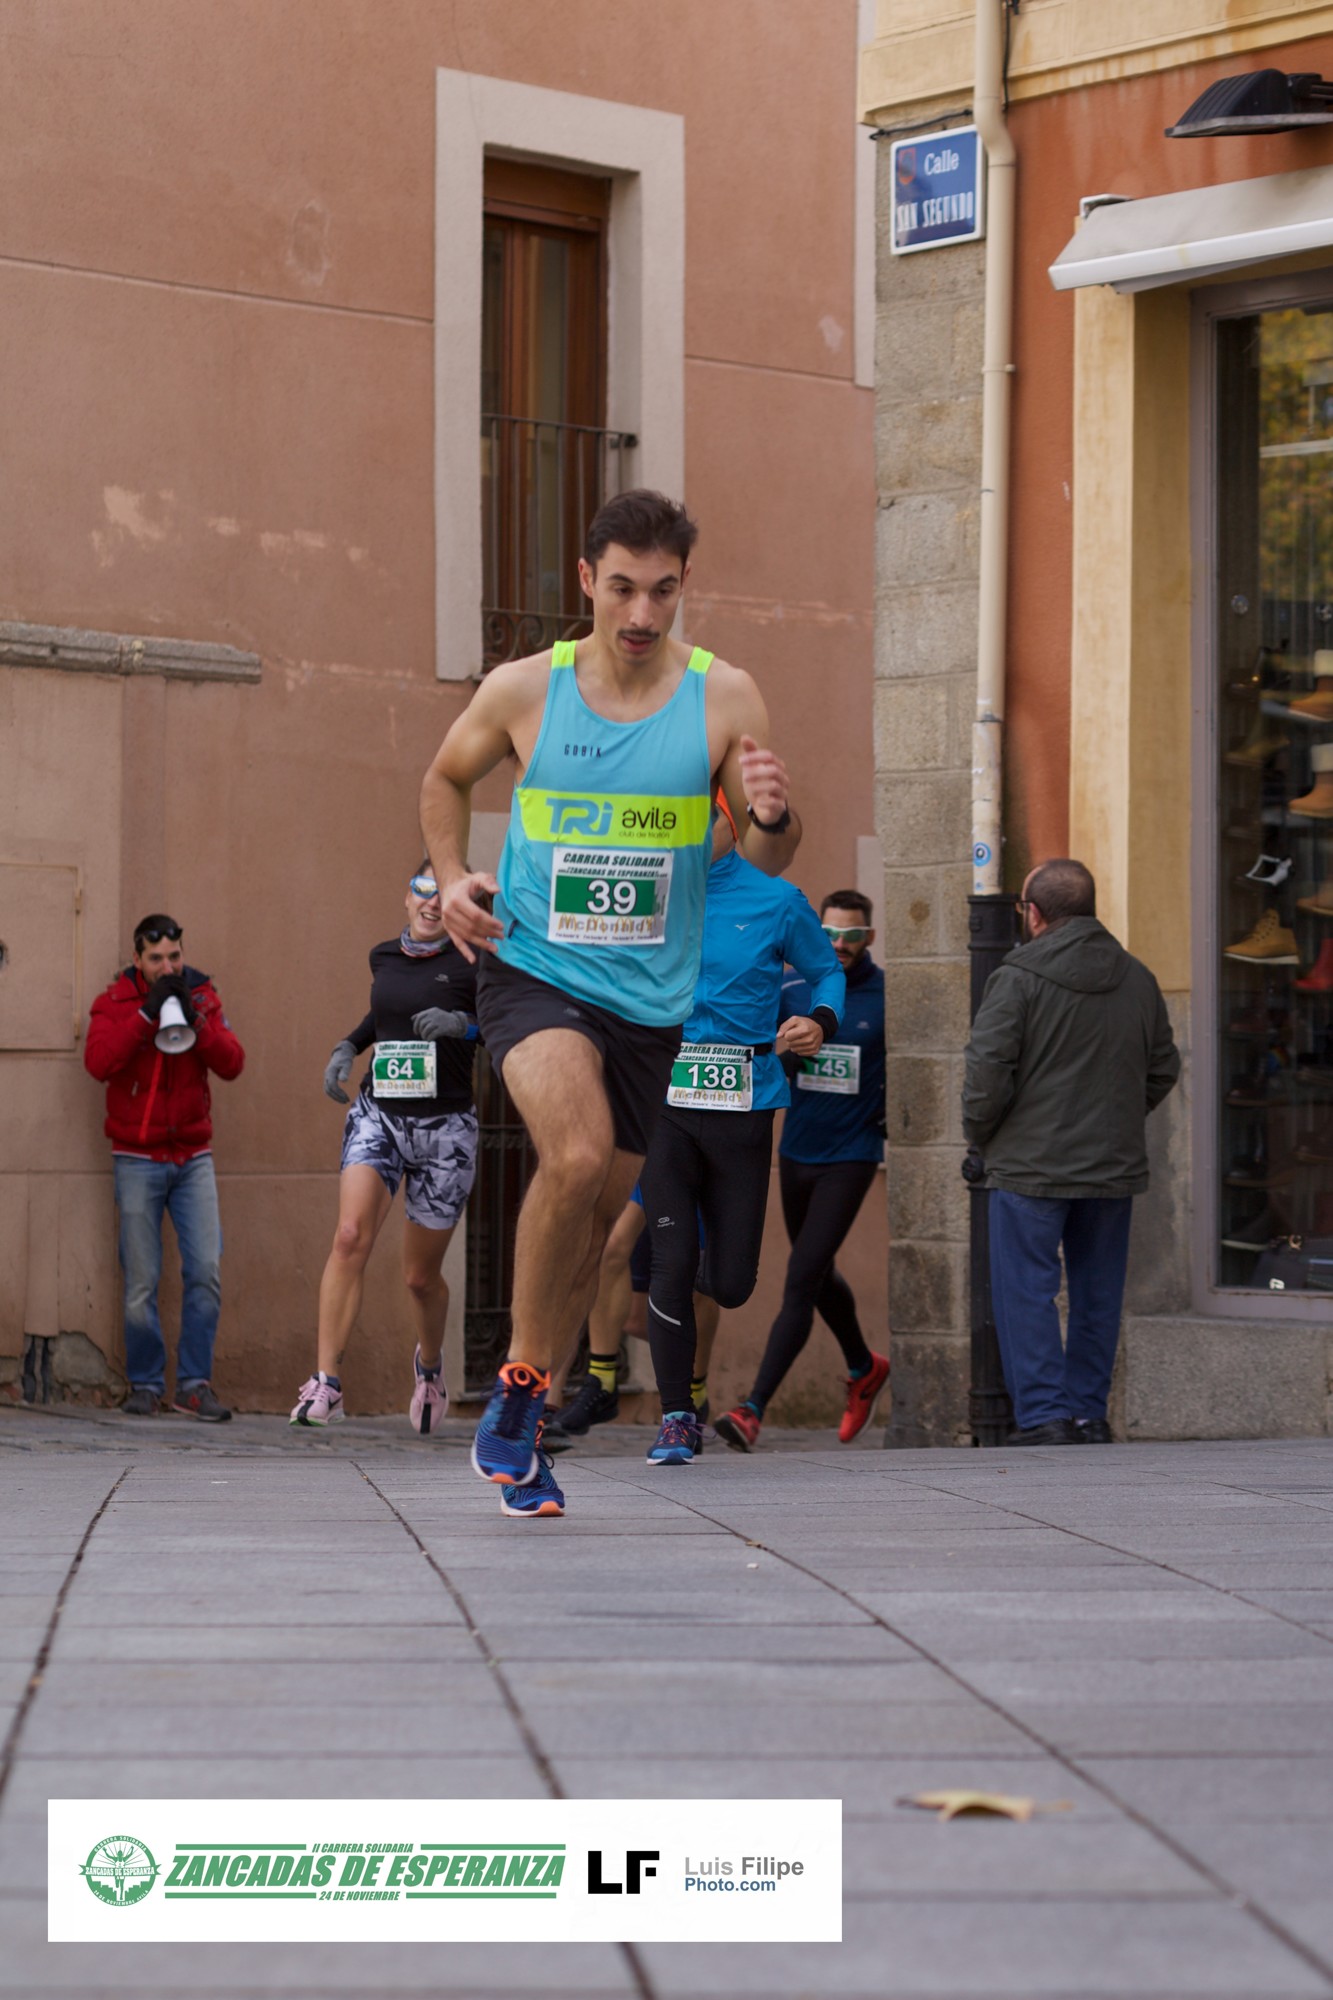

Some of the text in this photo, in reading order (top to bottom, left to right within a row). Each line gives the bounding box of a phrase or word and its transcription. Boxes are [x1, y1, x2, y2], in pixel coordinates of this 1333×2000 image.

[924, 149, 959, 175] Calle
[922, 191, 974, 228] SEGUNDO
[563, 853, 665, 867] CARRERA SOLIDARIA
[586, 879, 637, 915] 39
[387, 1058, 414, 1079] 64
[688, 1064, 737, 1089] 138
[814, 1060, 847, 1077] 145
